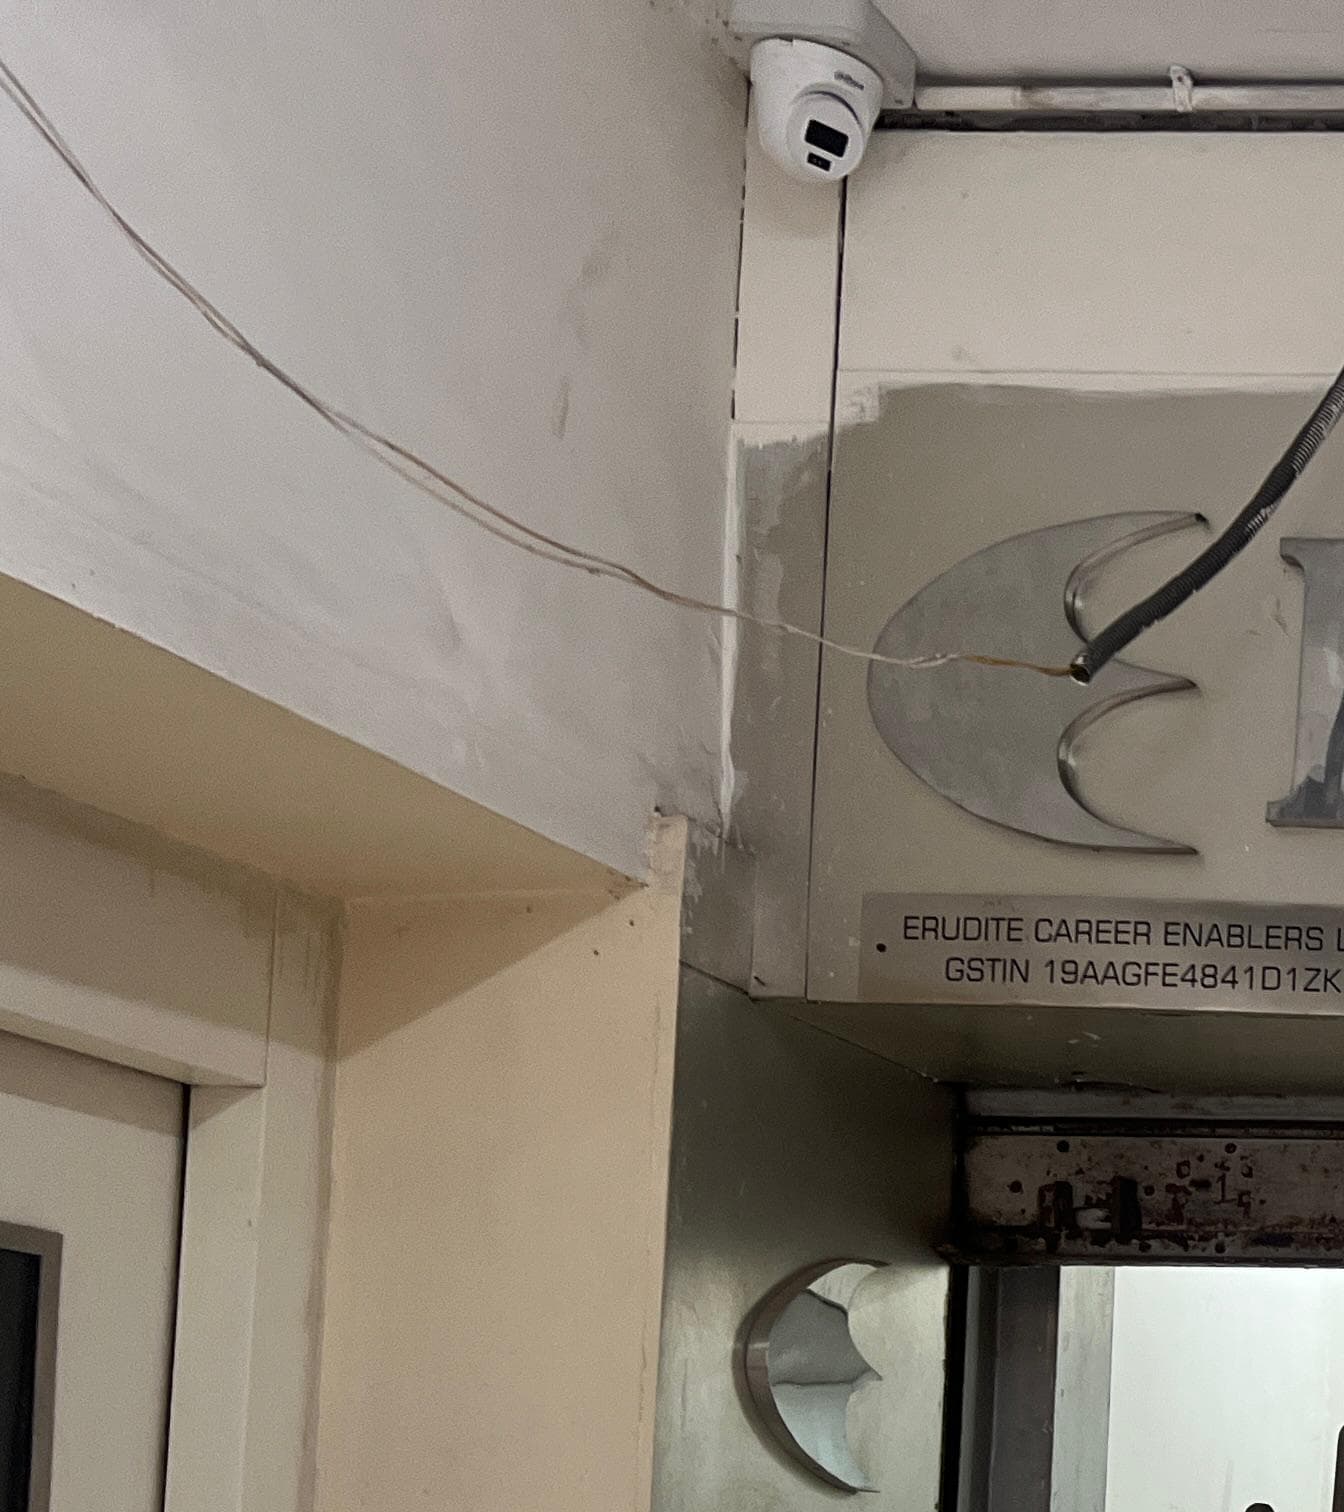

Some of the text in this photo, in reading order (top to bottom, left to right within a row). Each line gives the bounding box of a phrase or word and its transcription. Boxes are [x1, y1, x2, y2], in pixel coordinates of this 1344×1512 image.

[903, 916, 1023, 942] ERUDITE
[1034, 918, 1151, 946] CAREER
[1164, 923, 1324, 951] ENABLERS
[945, 958, 1341, 993] GSTIN 19AAGFE4841D1ZK
